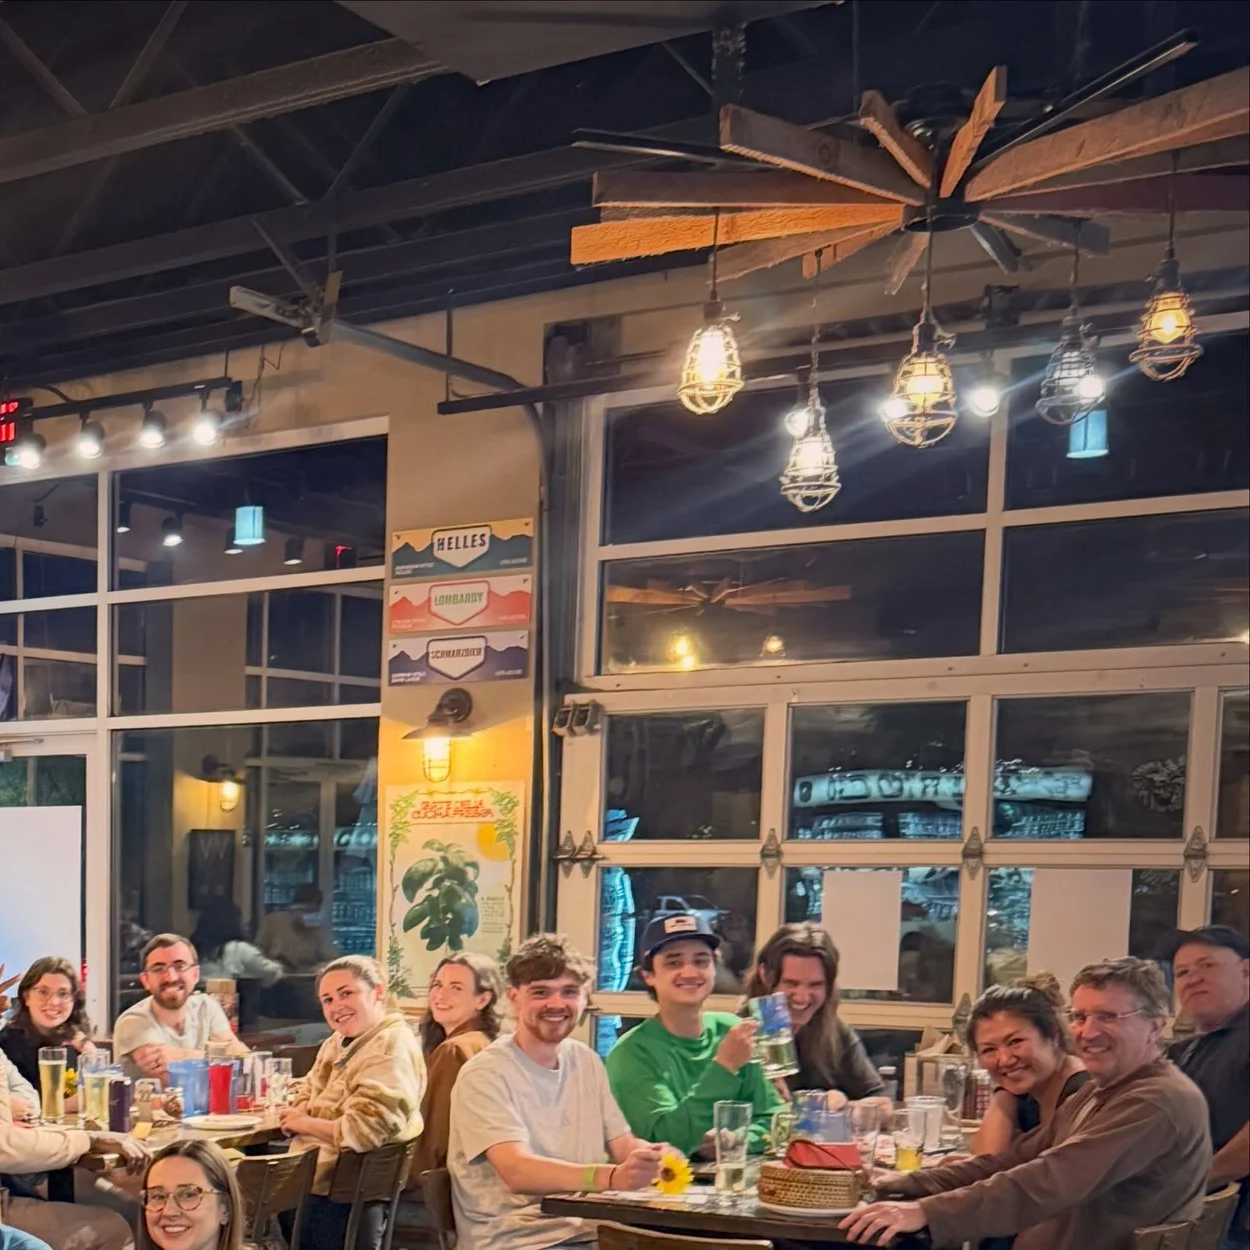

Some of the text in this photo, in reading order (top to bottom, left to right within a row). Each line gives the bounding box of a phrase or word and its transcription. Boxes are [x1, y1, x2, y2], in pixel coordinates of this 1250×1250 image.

[437, 533, 487, 551] HELLES
[434, 592, 484, 606] LOMBARDY
[431, 647, 482, 660] SCHWARZBIER
